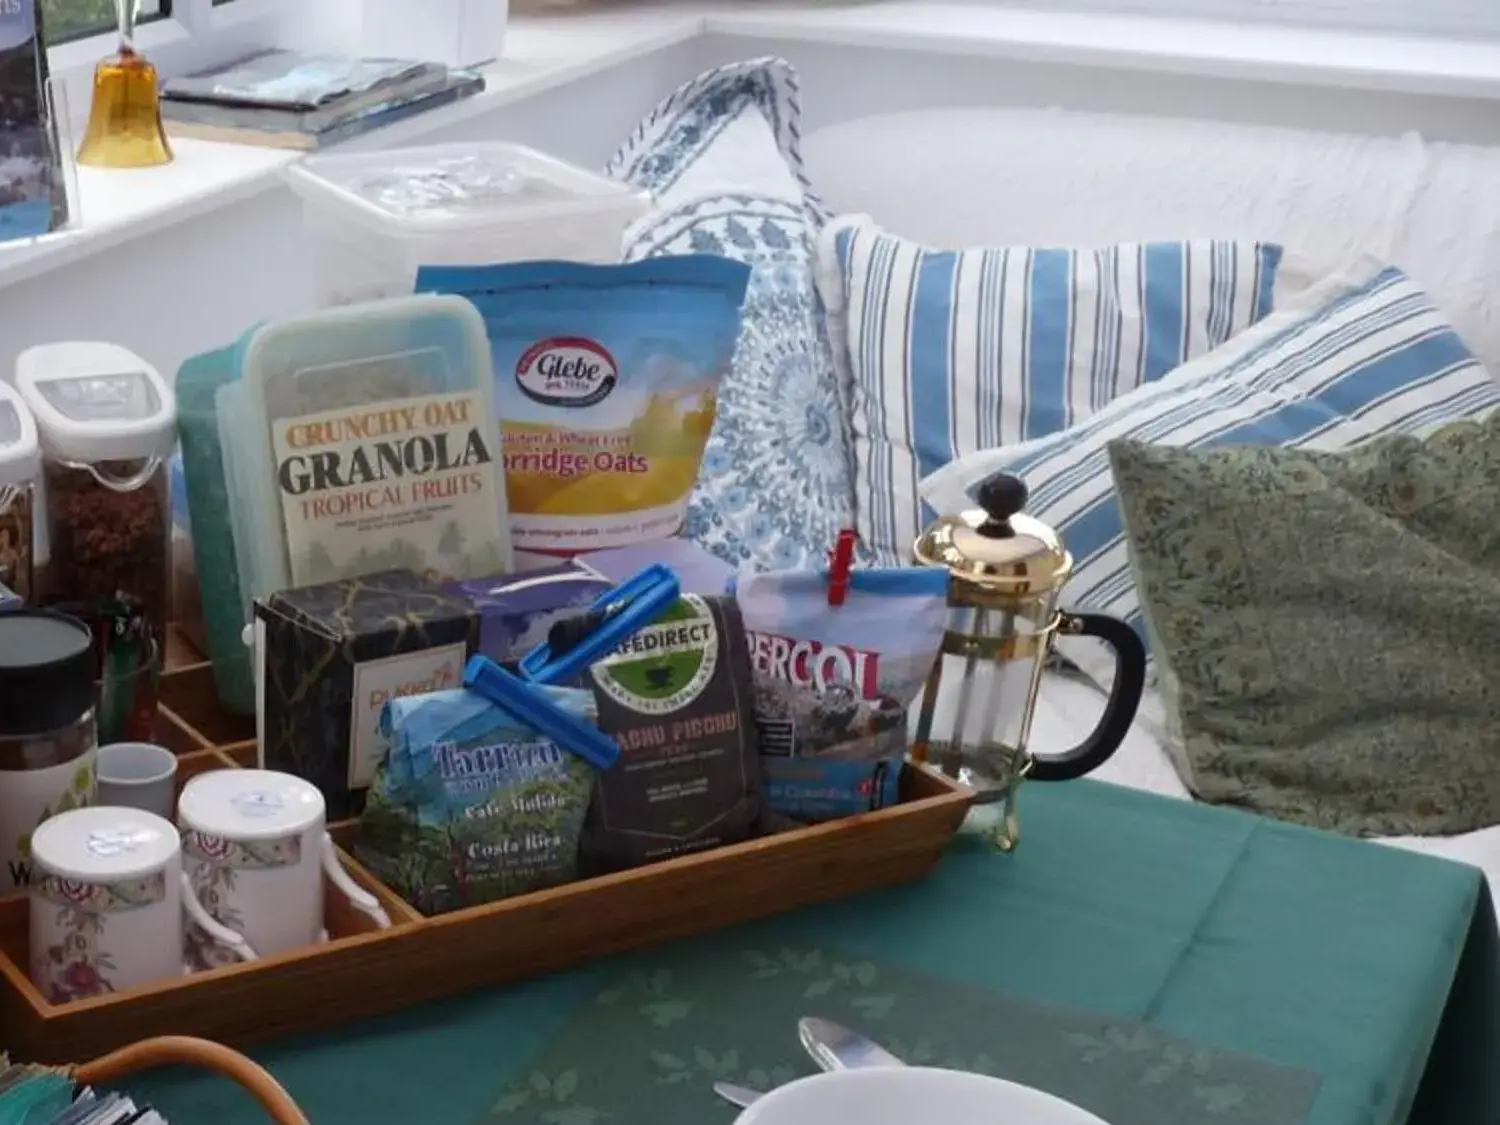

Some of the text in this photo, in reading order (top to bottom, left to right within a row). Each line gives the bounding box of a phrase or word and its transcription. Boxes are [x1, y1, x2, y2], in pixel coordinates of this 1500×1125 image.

[537, 352, 600, 382] Glebe
[286, 399, 472, 450] CRUNCHY OAT
[279, 427, 492, 496] GRANOLA
[594, 451, 649, 473] Oats
[300, 485, 403, 521] TROPICAL
[411, 473, 483, 501] FRUITS
[616, 725, 666, 751] ACHU
